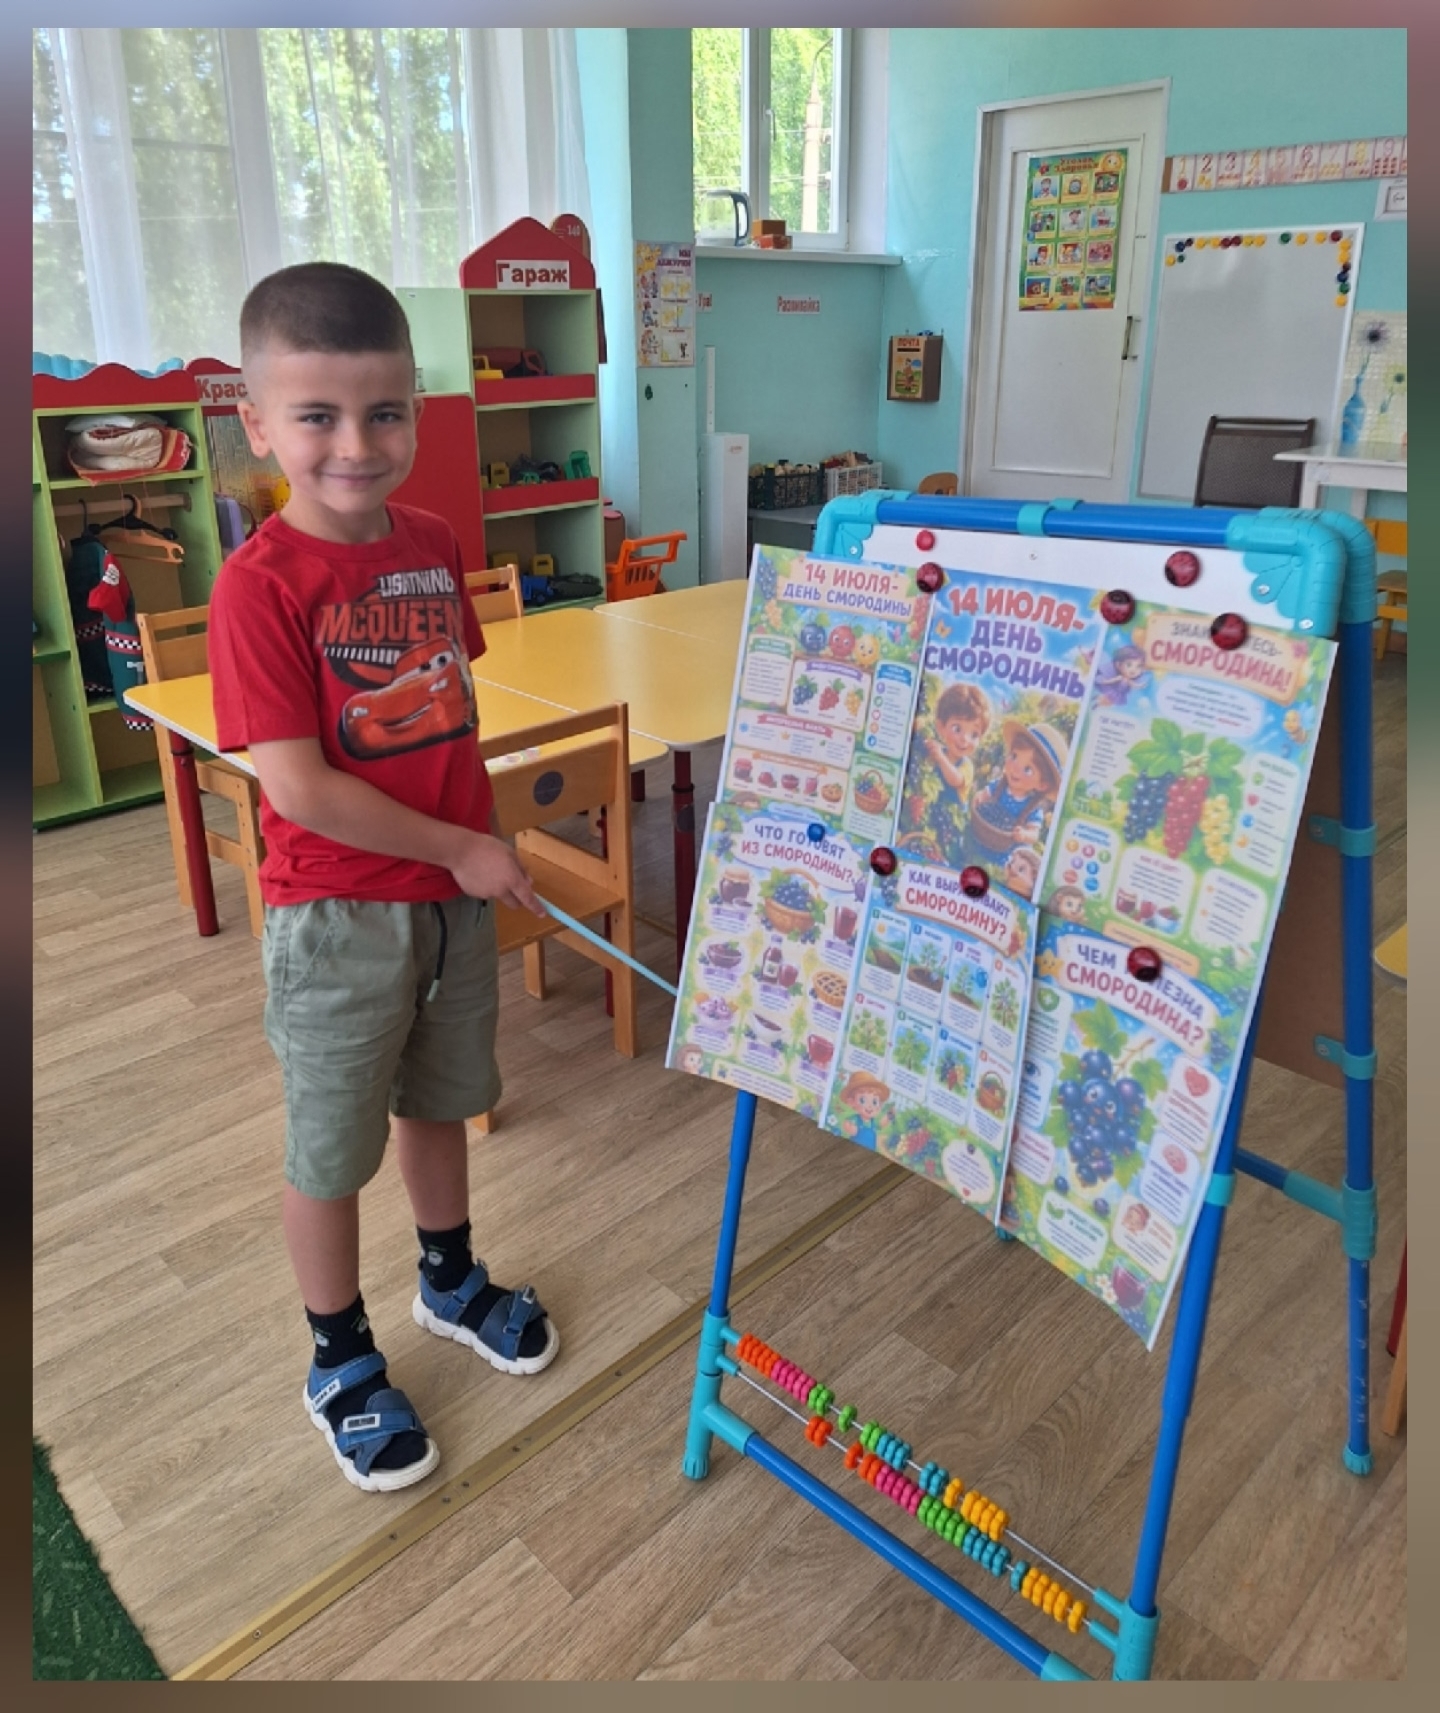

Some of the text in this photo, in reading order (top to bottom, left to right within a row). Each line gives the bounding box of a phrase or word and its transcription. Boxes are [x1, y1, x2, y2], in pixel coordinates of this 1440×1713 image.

[1201, 153, 1213, 173] 2
[1225, 151, 1237, 171] 3
[497, 263, 568, 287] Гараж
[897, 338, 920, 347] ПОЧТА
[379, 567, 455, 598] LIGHTNING
[805, 564, 899, 595] 14 ИЮЛЯ-
[782, 583, 912, 617] ДЕНЬ СМОРОДИНЫ
[949, 587, 1085, 633] 14 ИЮЛЯ-
[971, 619, 1043, 654] ДЕНЬ
[1150, 639, 1293, 693] СМОРОДИНА!
[754, 824, 846, 860] ЧТО ГООВЯТ
[741, 841, 854, 883] ИЗ СМОРОДИНЫ?
[908, 869, 932, 887] КАК
[905, 887, 1007, 941] СМОРОДИНУ?
[1077, 943, 1116, 970] ЧЕМ
[1066, 961, 1205, 1047] СМОРОДИНА?
